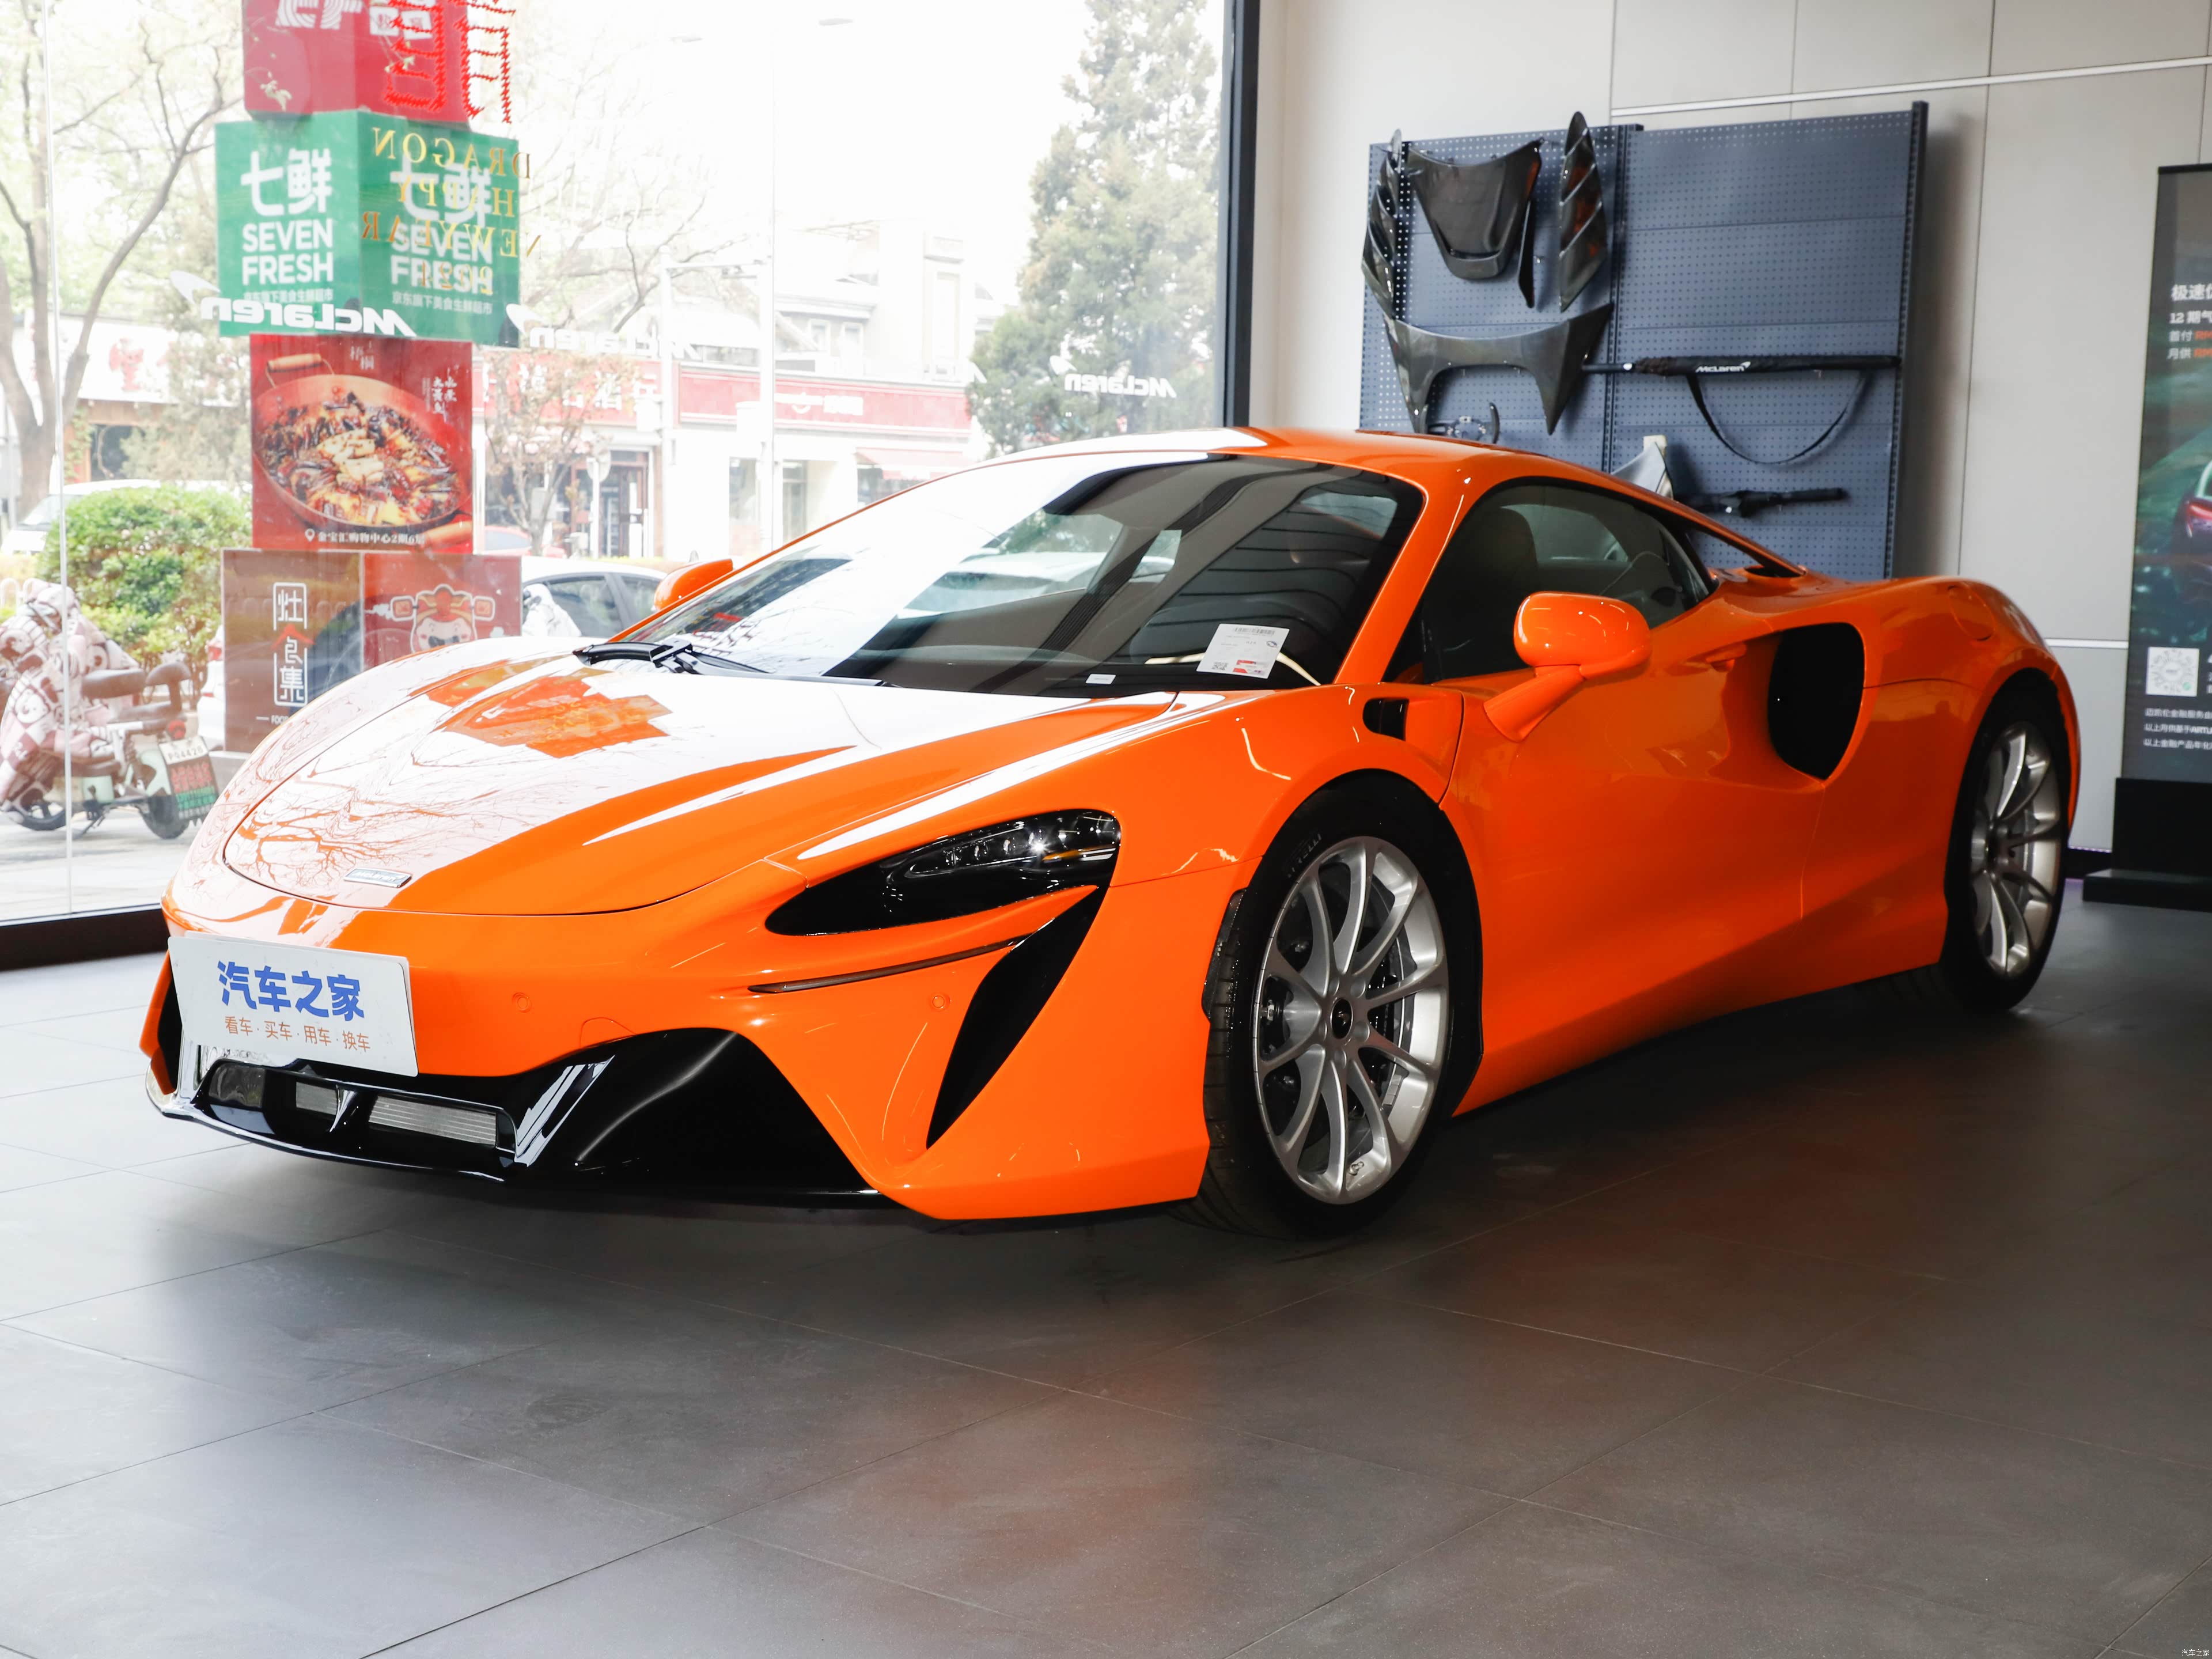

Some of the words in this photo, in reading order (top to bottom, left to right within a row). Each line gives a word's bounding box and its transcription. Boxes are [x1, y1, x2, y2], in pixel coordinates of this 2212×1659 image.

[240, 147, 332, 217] 七鲜
[389, 152, 493, 228] 七鲜
[242, 218, 333, 252] SEVEN
[391, 222, 494, 265] SEVEN
[242, 251, 333, 286] FRESH
[391, 255, 494, 295] FRESH
[2170, 313, 2184, 324] 12
[217, 960, 365, 1021] 汽车之家
